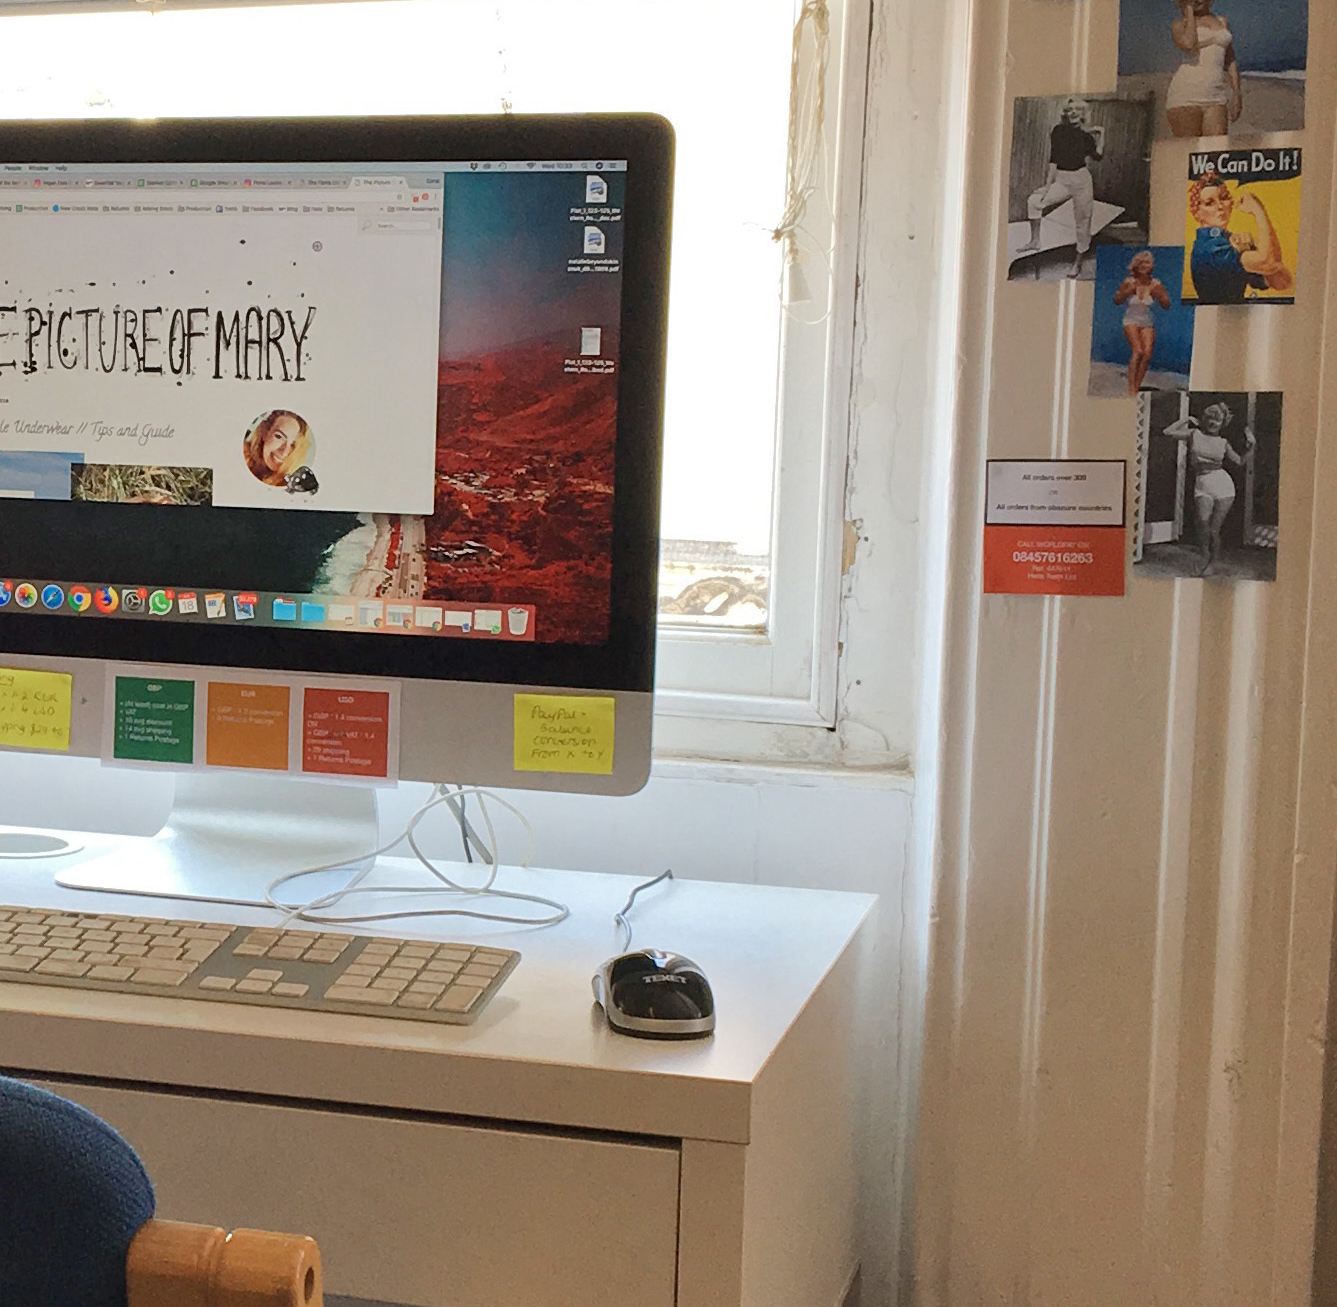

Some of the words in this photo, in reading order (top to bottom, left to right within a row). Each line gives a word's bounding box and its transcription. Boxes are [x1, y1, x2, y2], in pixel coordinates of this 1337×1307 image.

[1190, 154, 1215, 175] We
[1217, 153, 1248, 174] Can
[1251, 151, 1276, 172] Do
[1278, 150, 1299, 171] It!
[24, 305, 162, 375] PICTURE
[169, 305, 209, 376] OF
[212, 305, 317, 382] MARY
[13, 419, 73, 436] Underwear
[90, 421, 113, 442] Tips
[117, 424, 138, 437] and
[139, 424, 175, 446] Guide
[1012, 551, 1094, 564] 08457616263
[181, 600, 195, 611] 18
